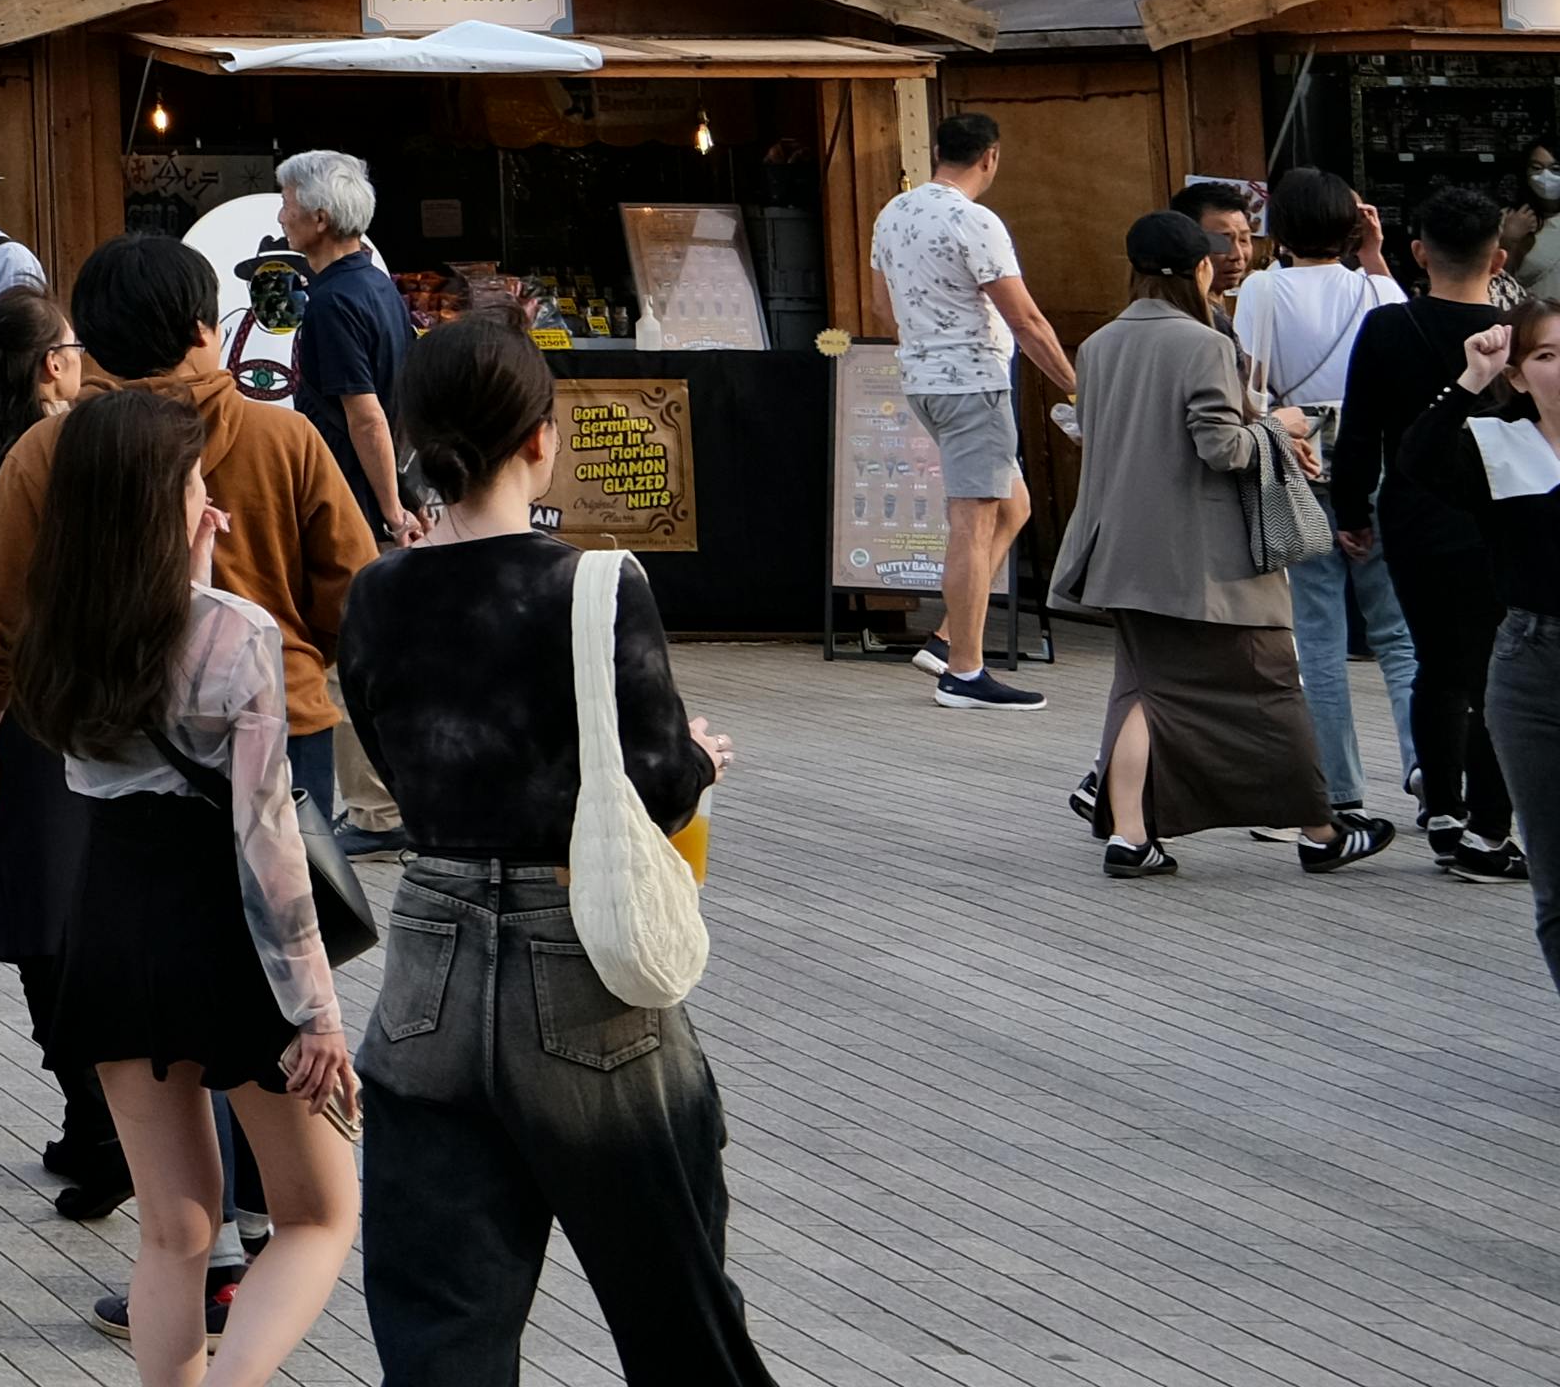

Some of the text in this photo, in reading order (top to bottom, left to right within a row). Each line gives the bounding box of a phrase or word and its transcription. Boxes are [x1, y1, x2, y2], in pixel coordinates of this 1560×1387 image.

[571, 432, 624, 450] Raised
[610, 444, 665, 461] Florida
[576, 458, 667, 481] CINNAMON
[602, 474, 666, 494] GLAZED
[626, 490, 672, 510] NUTS
[876, 560, 911, 575] NUTTY
